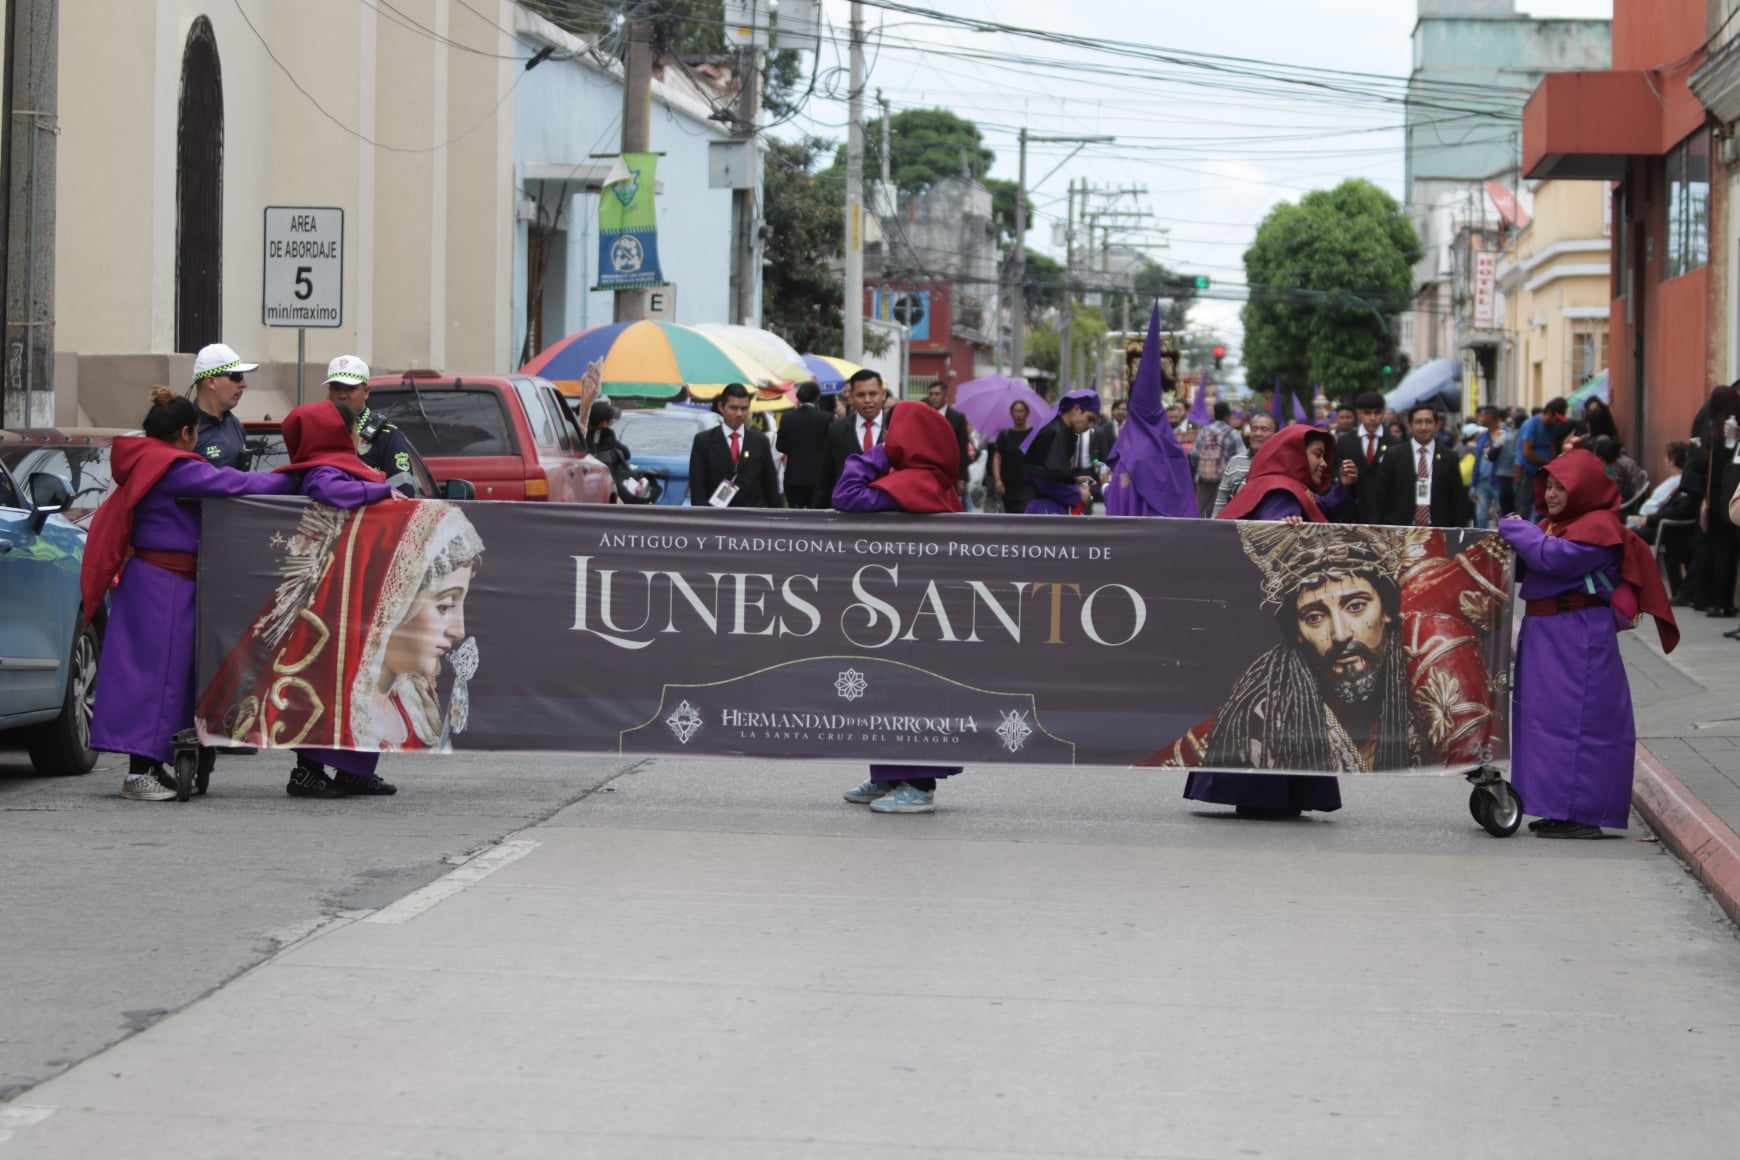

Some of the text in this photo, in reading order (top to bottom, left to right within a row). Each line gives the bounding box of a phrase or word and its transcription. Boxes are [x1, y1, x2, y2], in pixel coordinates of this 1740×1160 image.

[290, 215, 318, 232] AREA
[270, 240, 337, 259] DE ABORDAJE
[294, 266, 313, 300] 5
[267, 304, 338, 320] min/maximo
[649, 293, 664, 312] E
[599, 532, 1113, 560] ANTIGUO Y TRADICIONAL CORTEJO PROCESIONAL DE
[568, 554, 1148, 650] LUNES SANTO
[722, 709, 846, 729] HERMANDAD
[869, 715, 978, 735] PARROQUIA
[740, 730, 960, 743] LA SANTA CRUZ DEL MILAGRO
